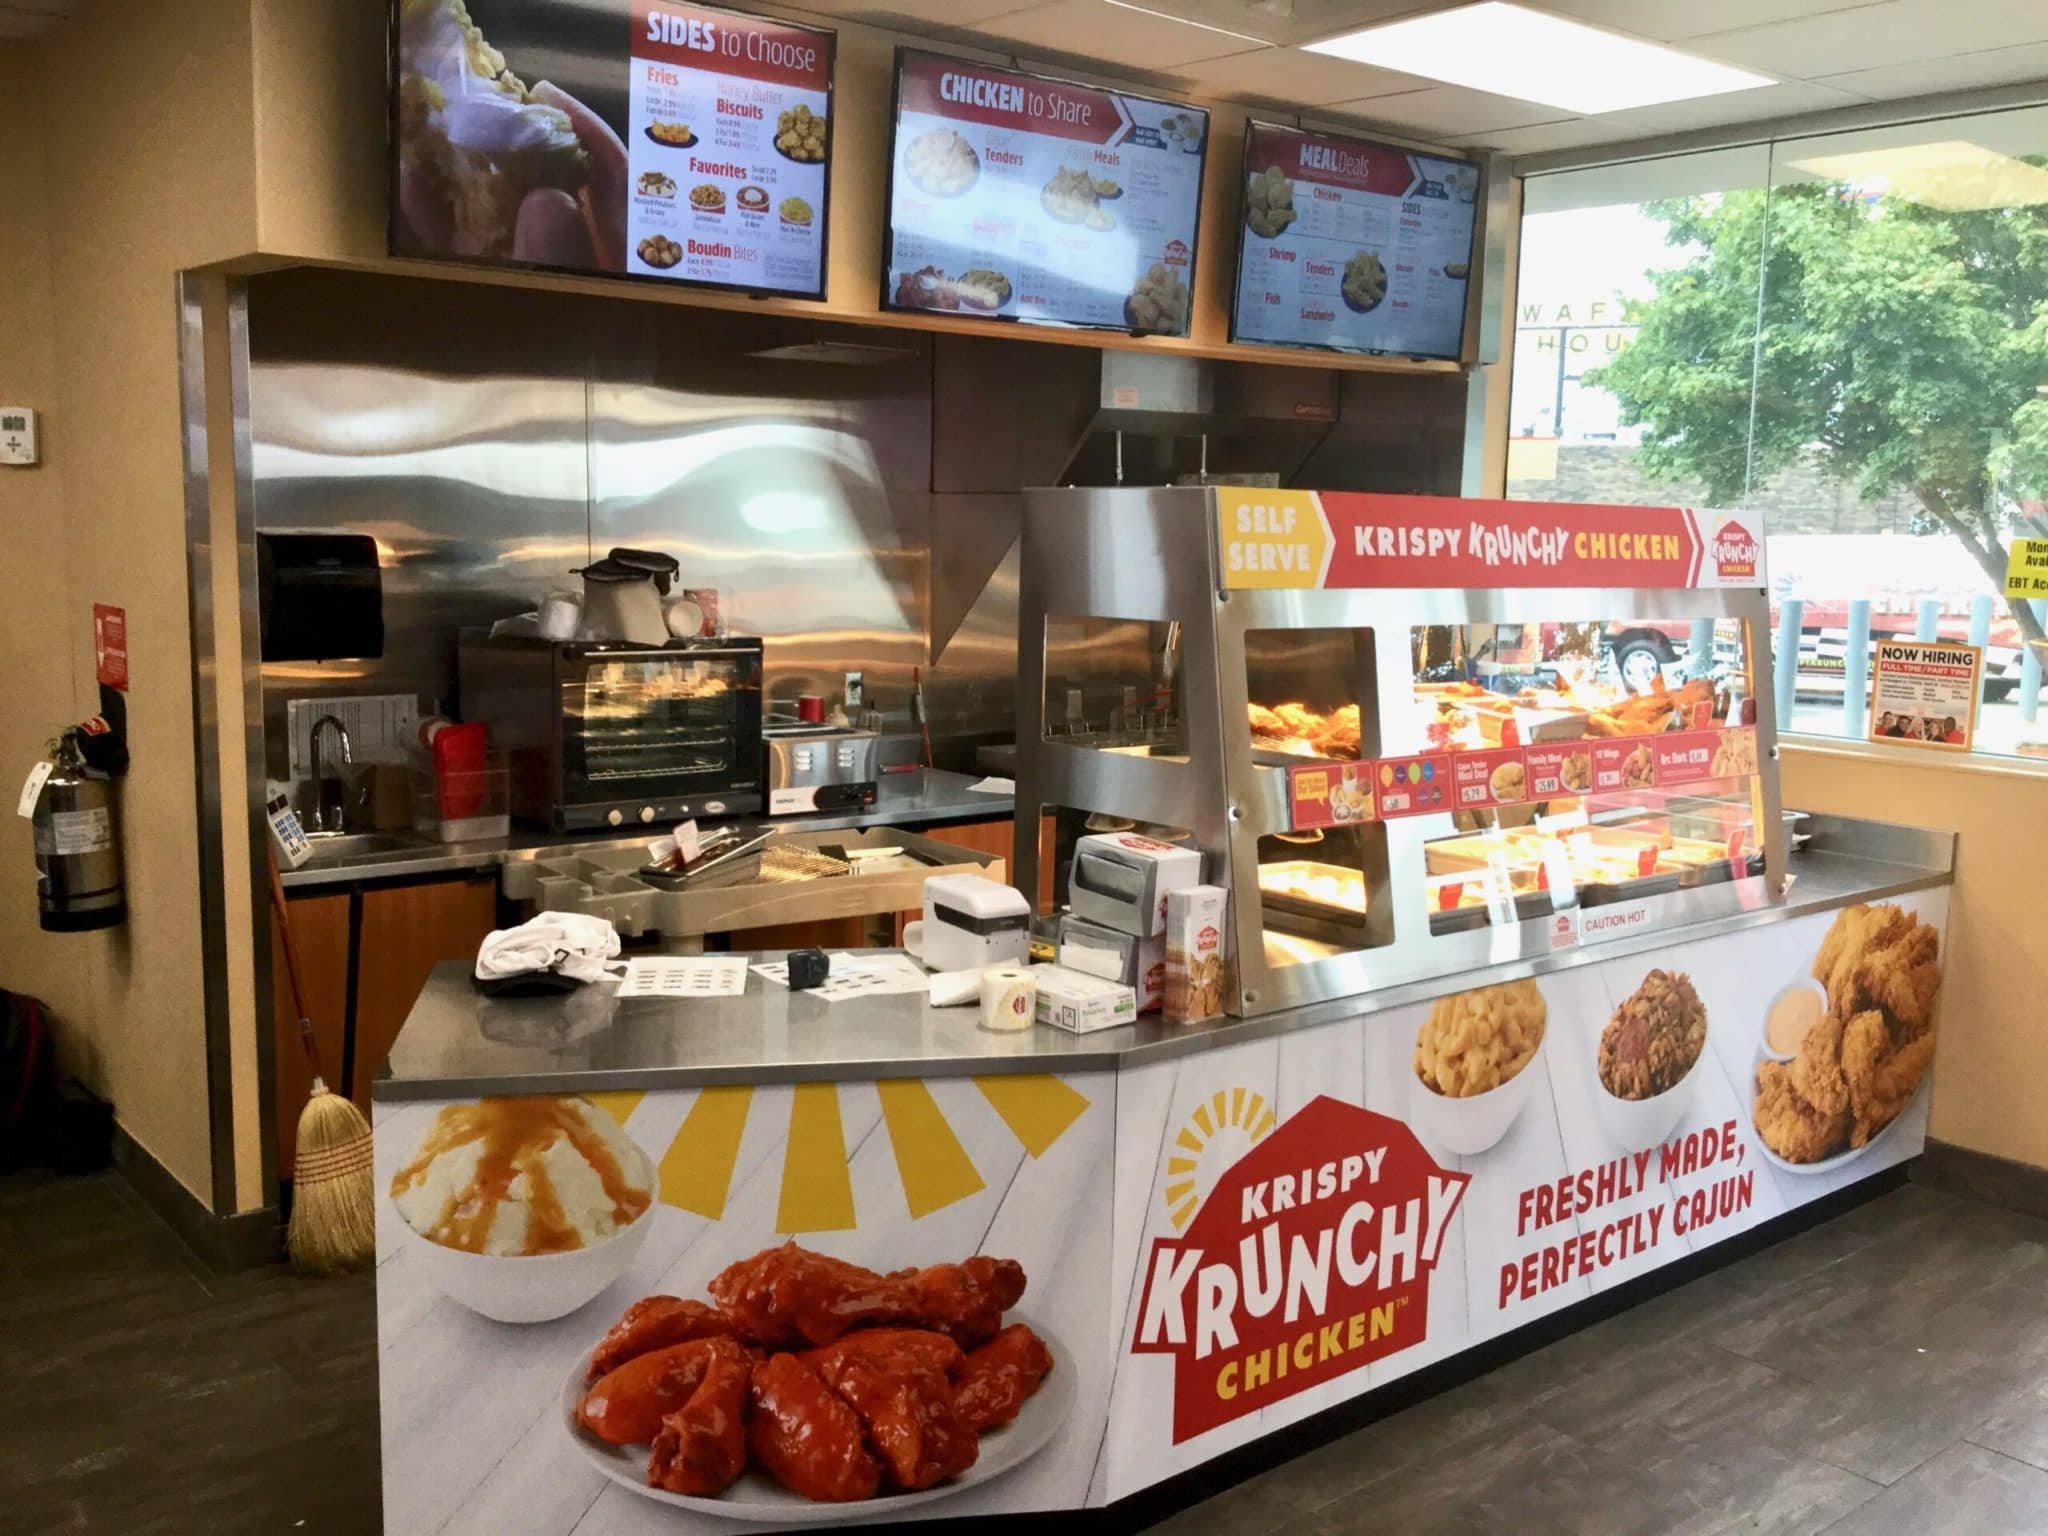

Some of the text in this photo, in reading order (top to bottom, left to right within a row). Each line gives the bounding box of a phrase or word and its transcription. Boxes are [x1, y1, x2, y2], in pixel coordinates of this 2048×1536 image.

[647, 11, 816, 72] SIDES to Choose
[647, 66, 679, 86] Fries
[752, 88, 783, 105] Butter
[940, 72, 1091, 126] CHICKEN to Share
[717, 98, 764, 120] Biscuits
[690, 157, 748, 180] Favorites
[985, 148, 1023, 167] Tenders
[1093, 150, 1120, 167] Meals
[1300, 144, 1338, 172] MEAL
[1338, 152, 1369, 178] Deals
[1313, 187, 1342, 202] Chicken
[1402, 202, 1421, 216] SIDES
[688, 239, 758, 262] Boudin Bites
[1269, 247, 1297, 263] Shrimp
[1305, 261, 1335, 277] Tenders
[1265, 292, 1281, 306] Fish
[1300, 307, 1336, 322] Sandwich
[1236, 504, 1297, 534] SELF
[1354, 521, 1680, 566] KRISPY KRUNCHY CHICKEN
[1711, 537, 1760, 563] KRUNCHY
[1228, 543, 1311, 572] SERVE
[2009, 577, 2029, 589] EBT
[1881, 648, 1973, 666] NOW HIRING
[1882, 662, 1902, 671] FULL
[1585, 910, 1646, 932] CAUTION HOT
[1241, 1146, 1388, 1225] KRISPY
[1517, 1119, 1746, 1237] FRESHLY MADE,
[1497, 1171, 1754, 1309] PERFECTLY CAJUN
[1140, 1175, 1463, 1360] KRUNCHY
